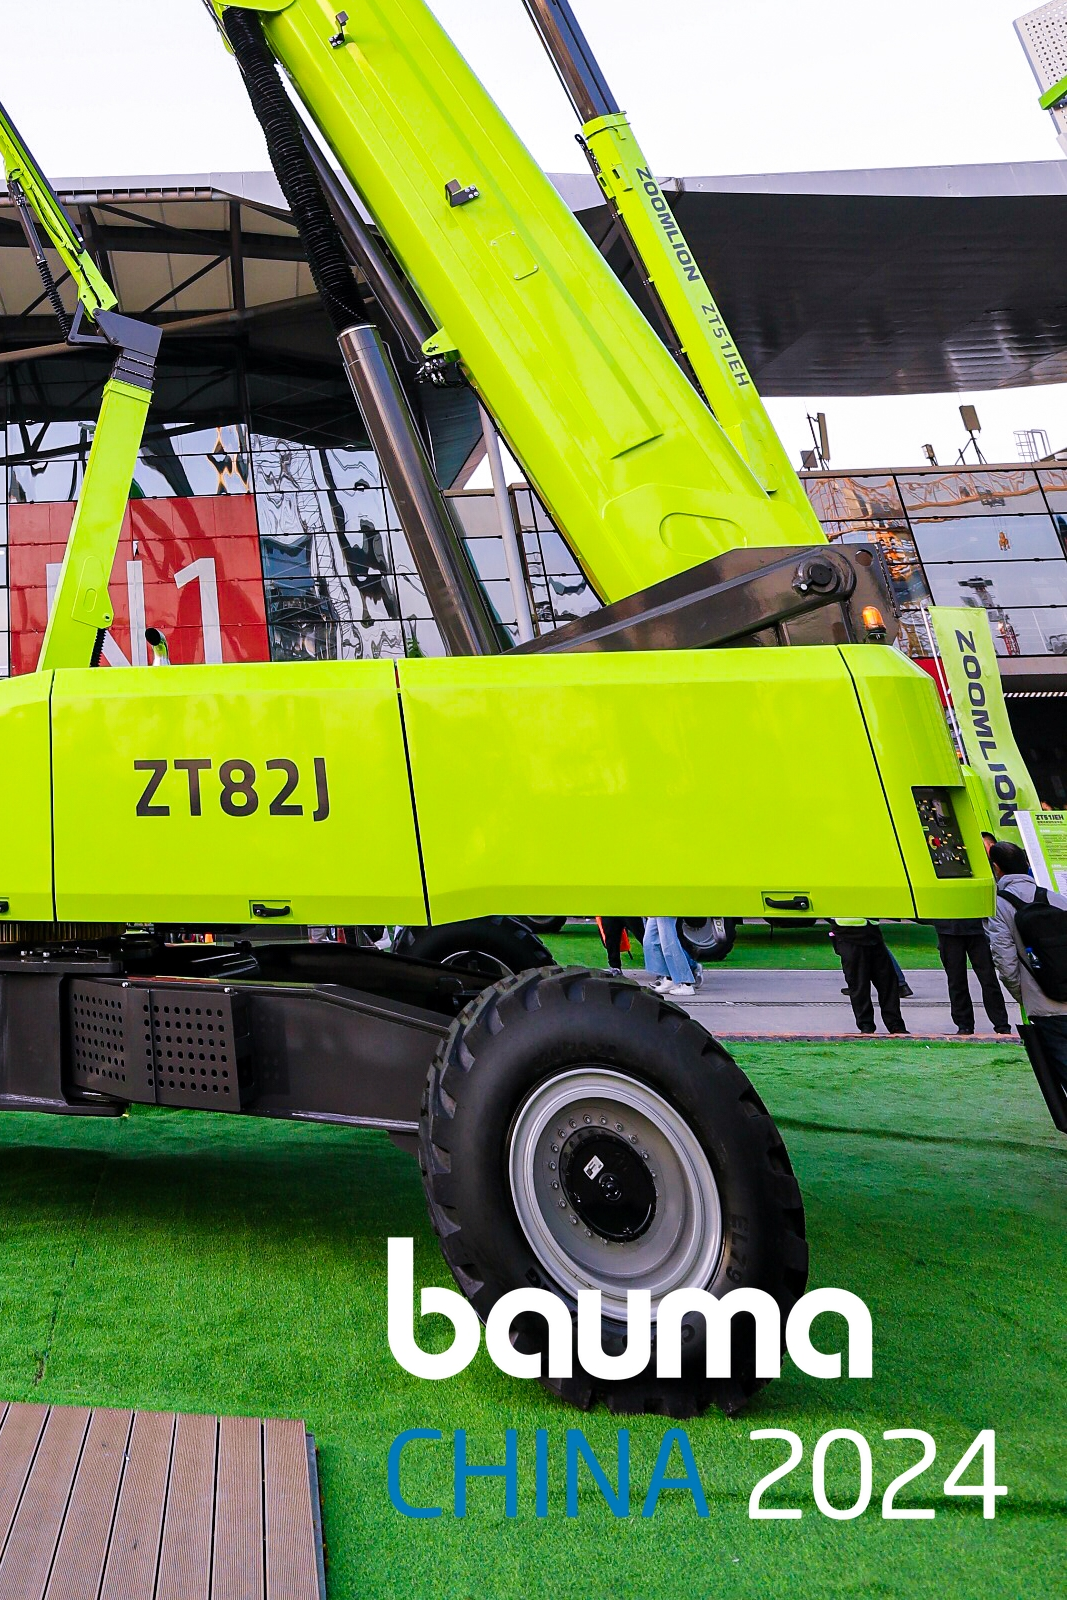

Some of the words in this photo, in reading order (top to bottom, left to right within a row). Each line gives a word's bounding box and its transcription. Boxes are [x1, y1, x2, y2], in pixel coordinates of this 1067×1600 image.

[636, 166, 700, 282] ZOOMLION
[701, 303, 750, 387] ZT51JEH
[133, 757, 331, 822] ZT82J
[954, 629, 1017, 827] ZOOMLION
